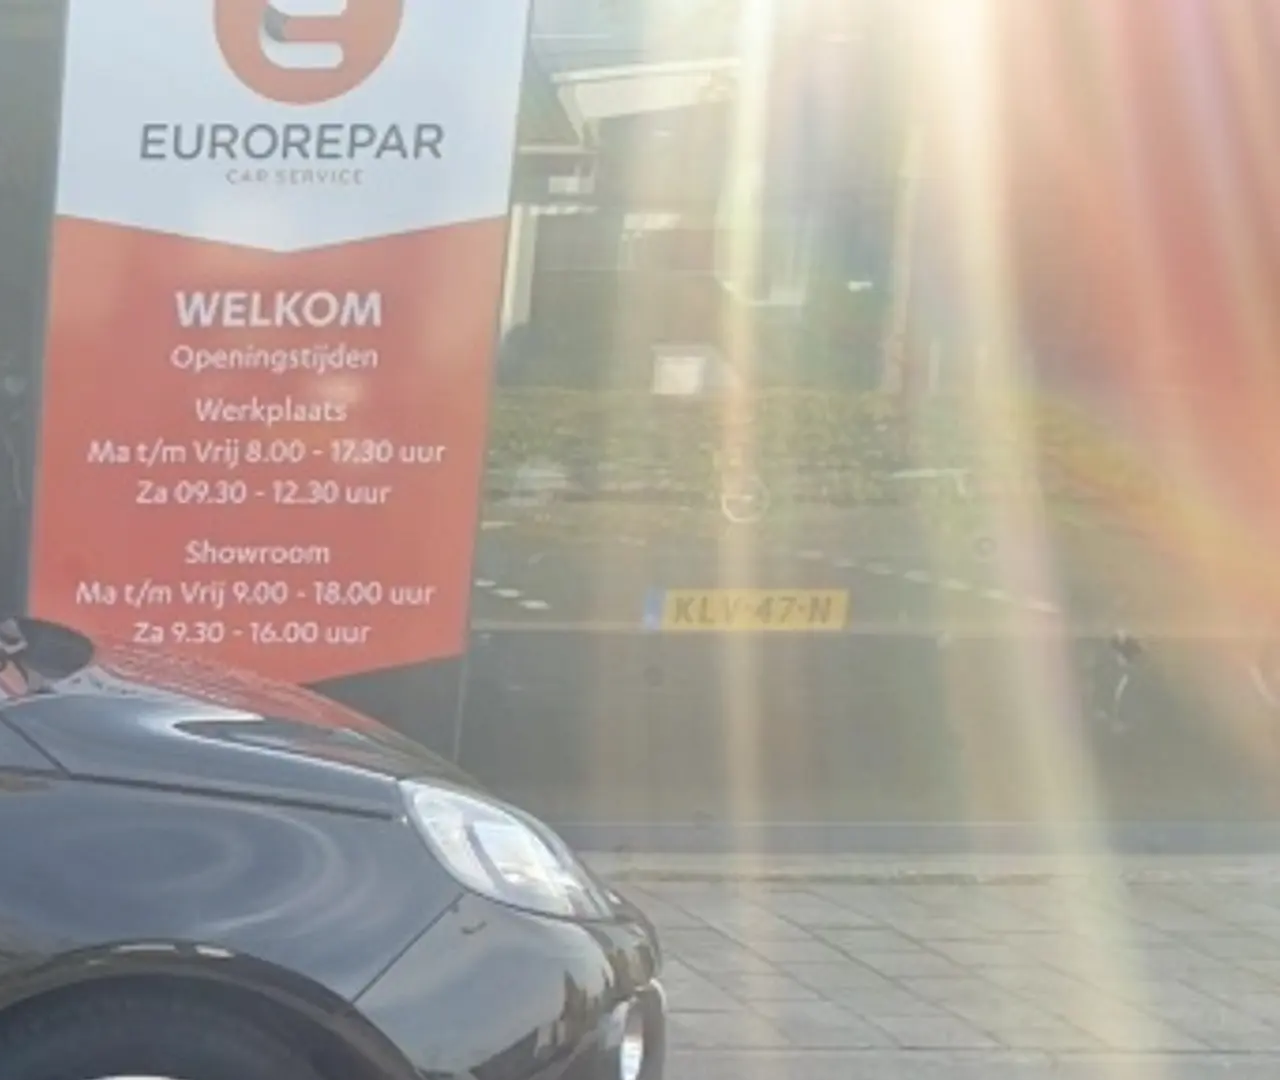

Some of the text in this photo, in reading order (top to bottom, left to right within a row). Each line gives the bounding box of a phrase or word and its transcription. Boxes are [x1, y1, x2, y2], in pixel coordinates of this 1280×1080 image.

[140, 123, 445, 160] EUROREPAR
[225, 169, 364, 186] CAR SERVICE
[174, 291, 382, 328] WELKOM
[170, 343, 378, 374] Openingstijden
[195, 397, 348, 427] Werkplaats
[87, 440, 130, 464] Ma
[136, 438, 186, 464] t/m
[192, 440, 240, 469] Vrij
[244, 439, 306, 464] 8.00
[331, 439, 394, 464] 17.30
[398, 445, 447, 463] uur
[136, 480, 168, 504] Za
[173, 480, 247, 504] 09.30
[272, 480, 339, 504] 12.30
[344, 486, 392, 504] uur
[184, 540, 330, 565] Showroom
[75, 581, 115, 605] Ma
[124, 580, 172, 607] t/m
[178, 581, 225, 610] Vrij
[232, 581, 288, 604] 9.00
[314, 581, 382, 605] 18.00
[389, 586, 436, 605] uur
[133, 621, 165, 645] Za
[171, 621, 224, 644] 9.30
[249, 621, 317, 644] 16.00
[324, 626, 371, 644] uur
